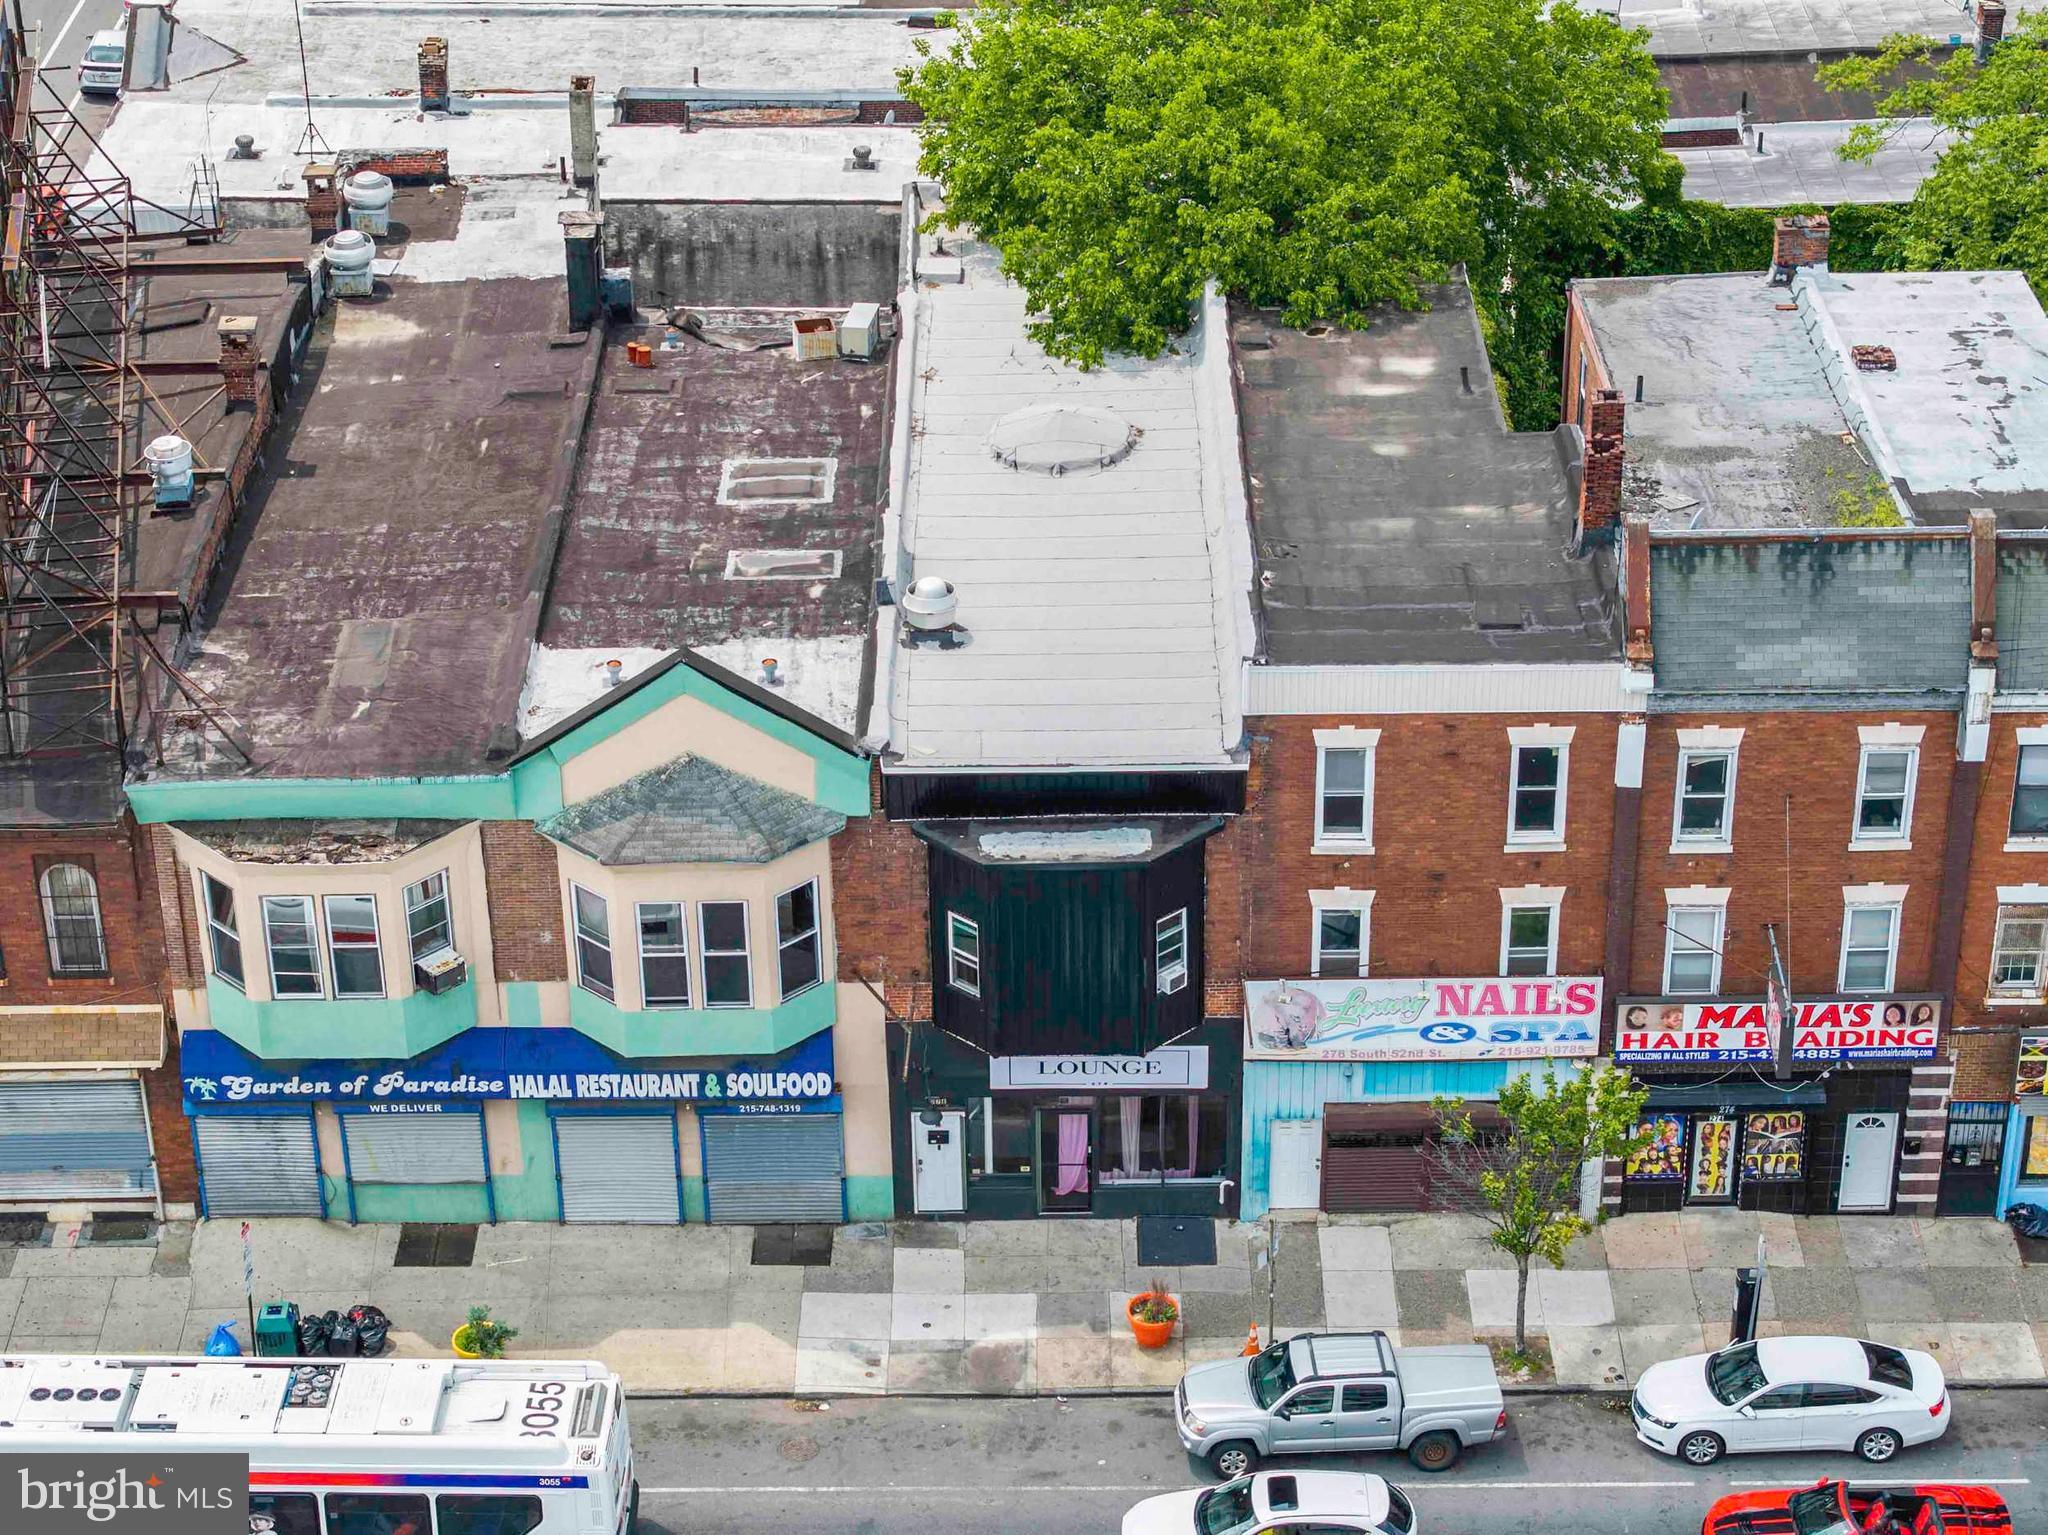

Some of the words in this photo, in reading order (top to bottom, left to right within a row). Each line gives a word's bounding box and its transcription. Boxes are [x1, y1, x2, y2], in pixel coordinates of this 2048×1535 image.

[1320, 986, 1430, 1031] Luxury
[1435, 983, 1596, 1016] NAILS
[1695, 1003, 1875, 1030] MAIA'S
[1427, 1026, 1469, 1041] &
[1489, 1020, 1594, 1042] SPA
[1622, 1032, 1720, 1049] HAIR
[1744, 1028, 1935, 1049] BAIDING
[1350, 1048, 1387, 1059] South
[1389, 1048, 1424, 1058] 52nd
[1428, 1048, 1447, 1058] St.
[1619, 1051, 1662, 1061] SPECIALIZING
[1663, 1051, 1671, 1060] IN
[1672, 1051, 1684, 1060] ALL
[1685, 1051, 1710, 1060] STYLES
[1039, 1060, 1161, 1075] LOUNGE
[220, 1075, 332, 1099] Garden
[339, 1075, 369, 1096] of
[373, 1071, 504, 1097] Paradise
[508, 1074, 573, 1099] HALAL
[576, 1073, 700, 1099] RESTAURANT
[704, 1073, 722, 1098] &
[725, 1072, 832, 1098] SOULFOOD
[369, 1104, 388, 1113] WE
[390, 1104, 442, 1113] DELIVER
[539, 1478, 561, 1486] 3055
